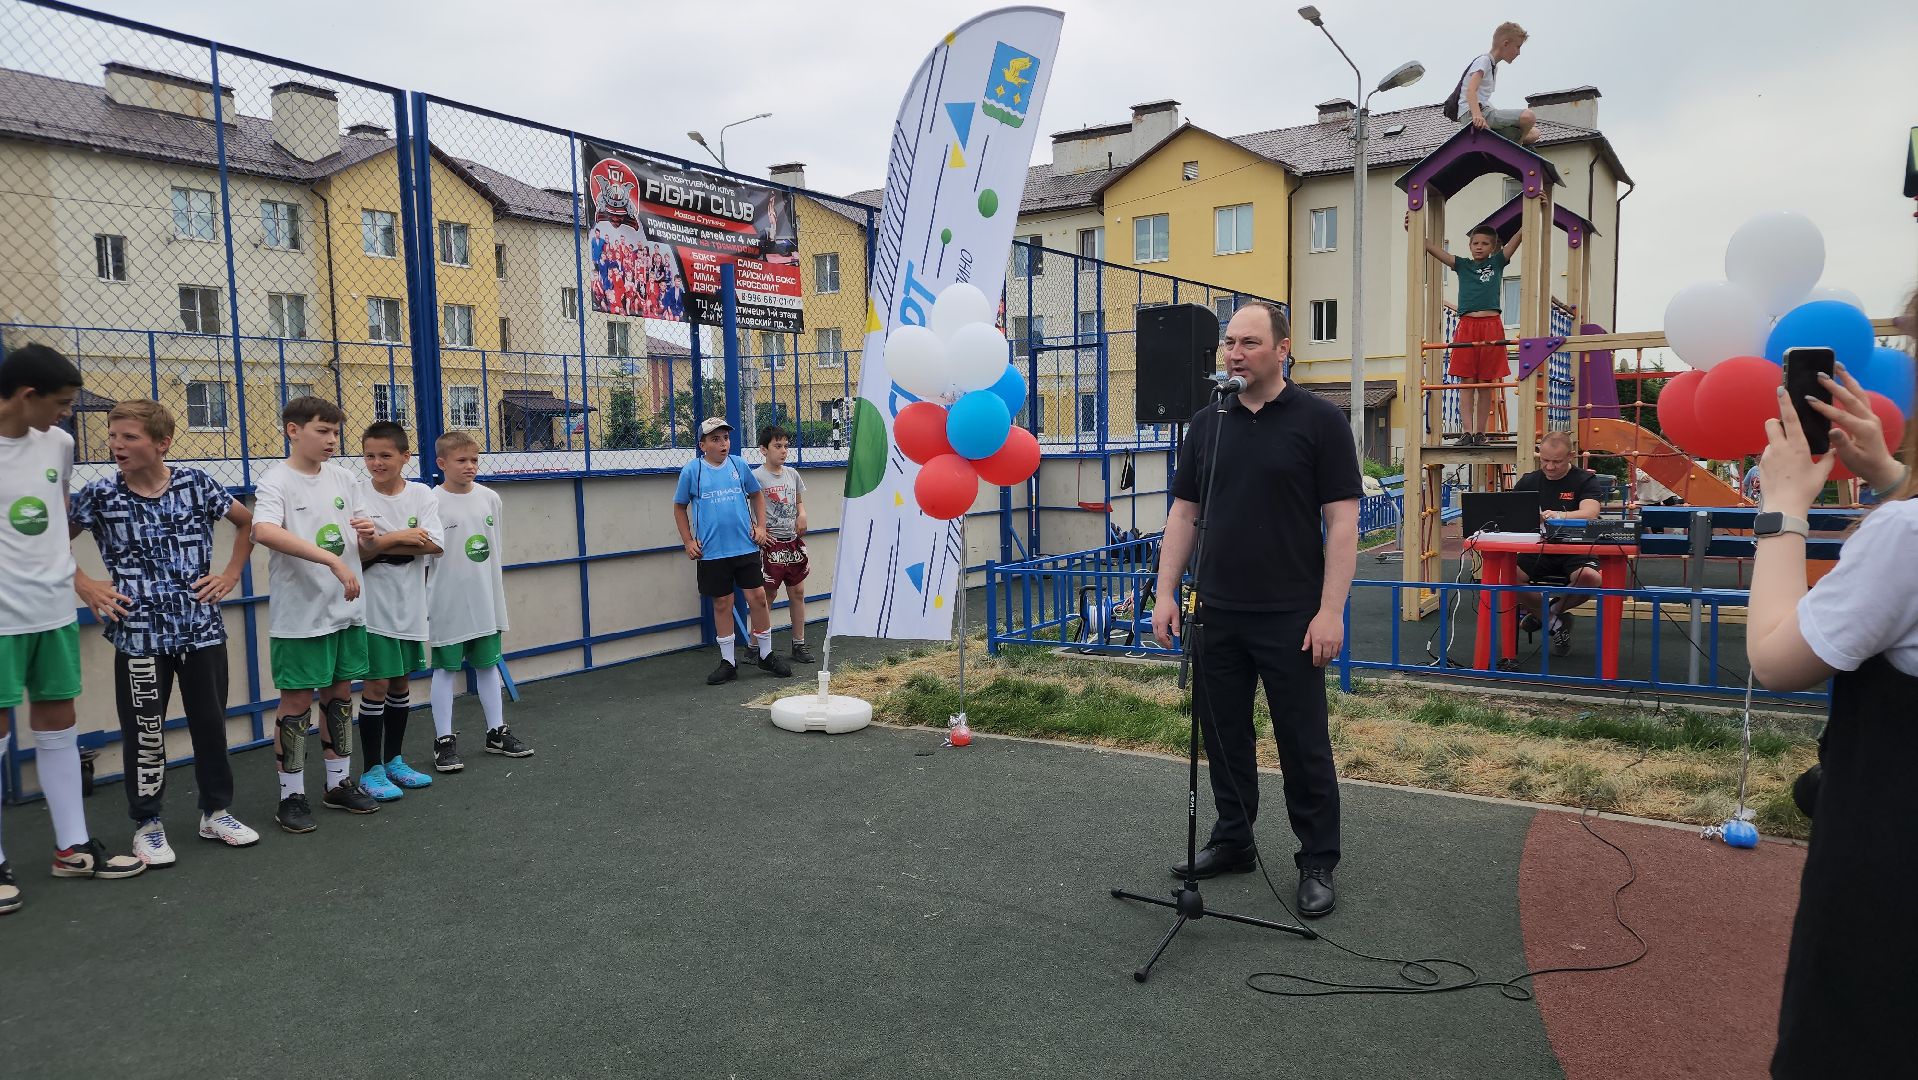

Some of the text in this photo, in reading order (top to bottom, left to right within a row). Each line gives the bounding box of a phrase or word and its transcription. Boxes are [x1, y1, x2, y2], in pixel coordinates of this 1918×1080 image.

[645, 178, 755, 222] FIGHT CLUB
[647, 218, 760, 246] приглашает детей от 4 лет
[648, 227, 655, 236] и
[656, 231, 698, 246] взрослых
[691, 251, 717, 262] БОКС
[737, 258, 763, 270] САМБО
[693, 271, 716, 282] ММА
[737, 269, 797, 285] ТАЙСКИЙ БОКС
[736, 279, 780, 292] КРОССФИТ
[695, 298, 708, 311] ТЦ
[701, 487, 742, 499] ETIHAD
[128, 656, 165, 797] ULL POWER
